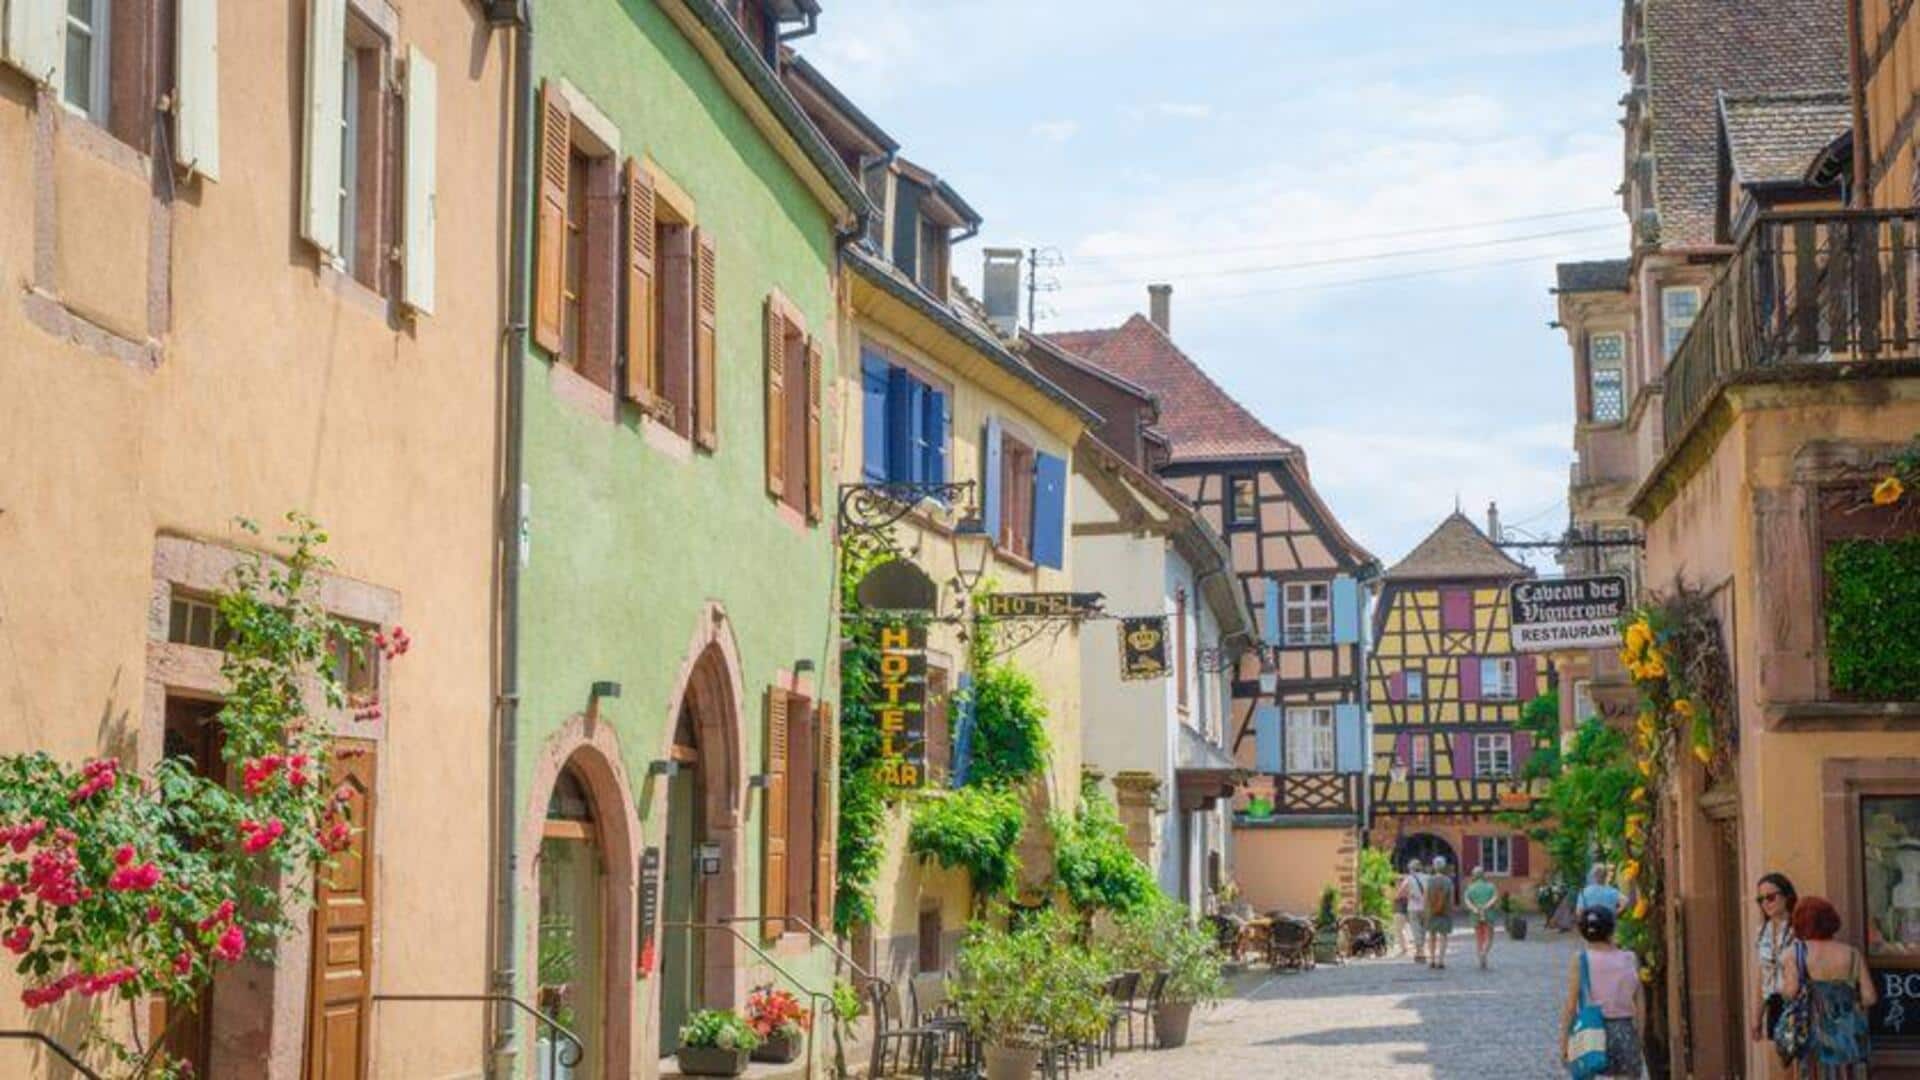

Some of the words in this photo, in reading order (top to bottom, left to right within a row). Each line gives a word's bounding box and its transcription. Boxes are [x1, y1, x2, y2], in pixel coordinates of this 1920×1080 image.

[1515, 584, 1585, 602] Caveau
[1589, 581, 1620, 599] des
[993, 596, 1082, 614] HOTEL
[1521, 602, 1618, 623] Vignerons
[1521, 622, 1618, 642] RESTAURANT
[881, 627, 908, 759] HOTEL
